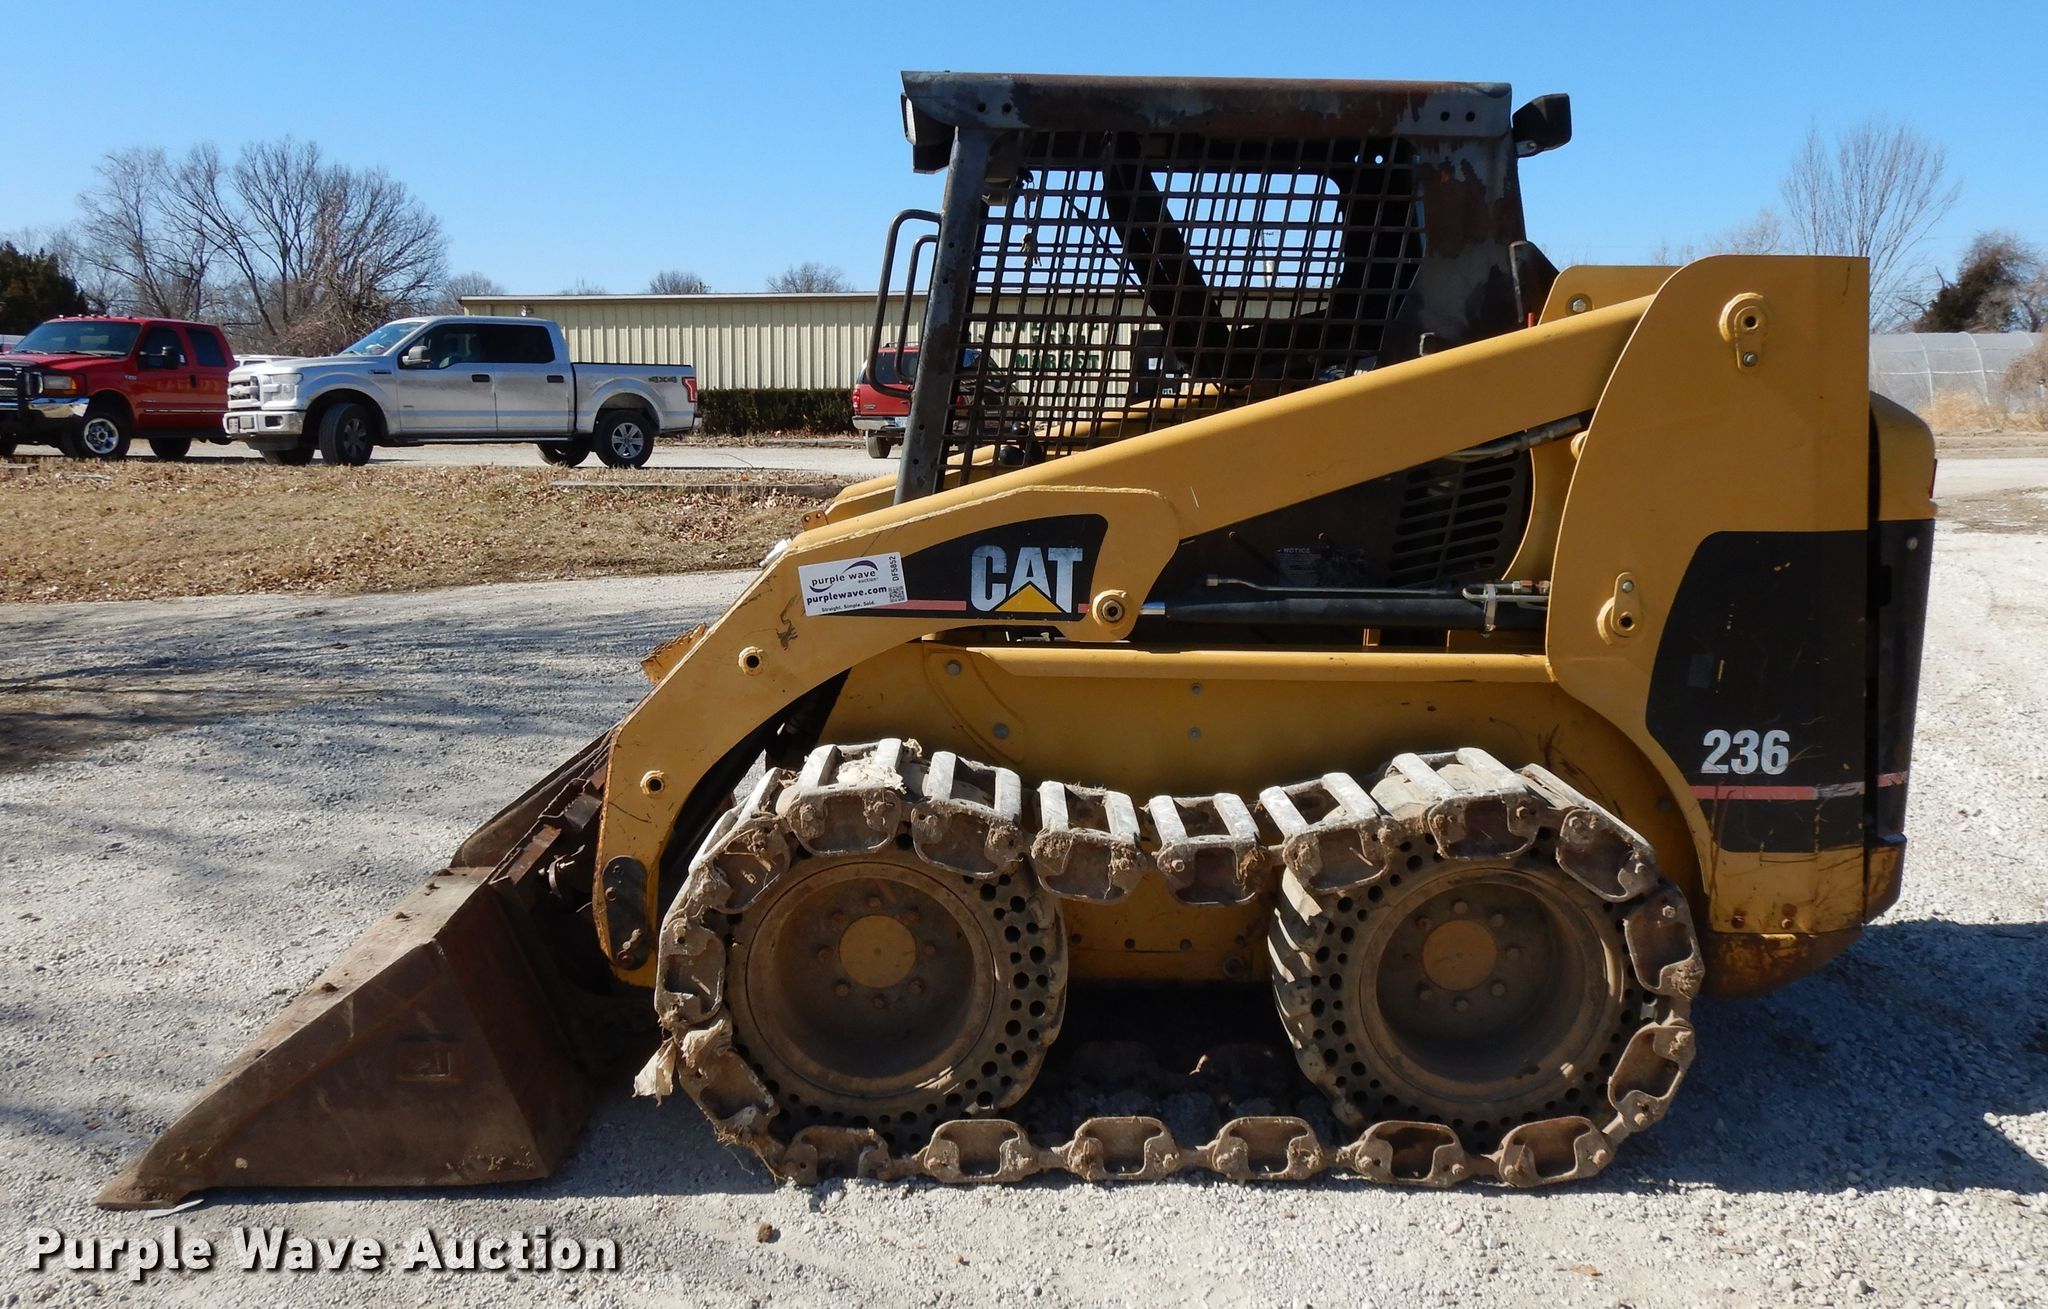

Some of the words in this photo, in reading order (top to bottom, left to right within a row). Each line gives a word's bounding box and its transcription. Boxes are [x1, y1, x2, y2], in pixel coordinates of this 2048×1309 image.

[1015, 353, 1100, 370] MARKET
[811, 574, 846, 587] purple
[848, 569, 876, 580] wave
[970, 544, 1084, 614] CAT
[806, 586, 888, 606] purplewave.com
[821, 605, 842, 613] Straight.
[843, 602, 862, 610] Simple.
[1701, 729, 1790, 775] 236
